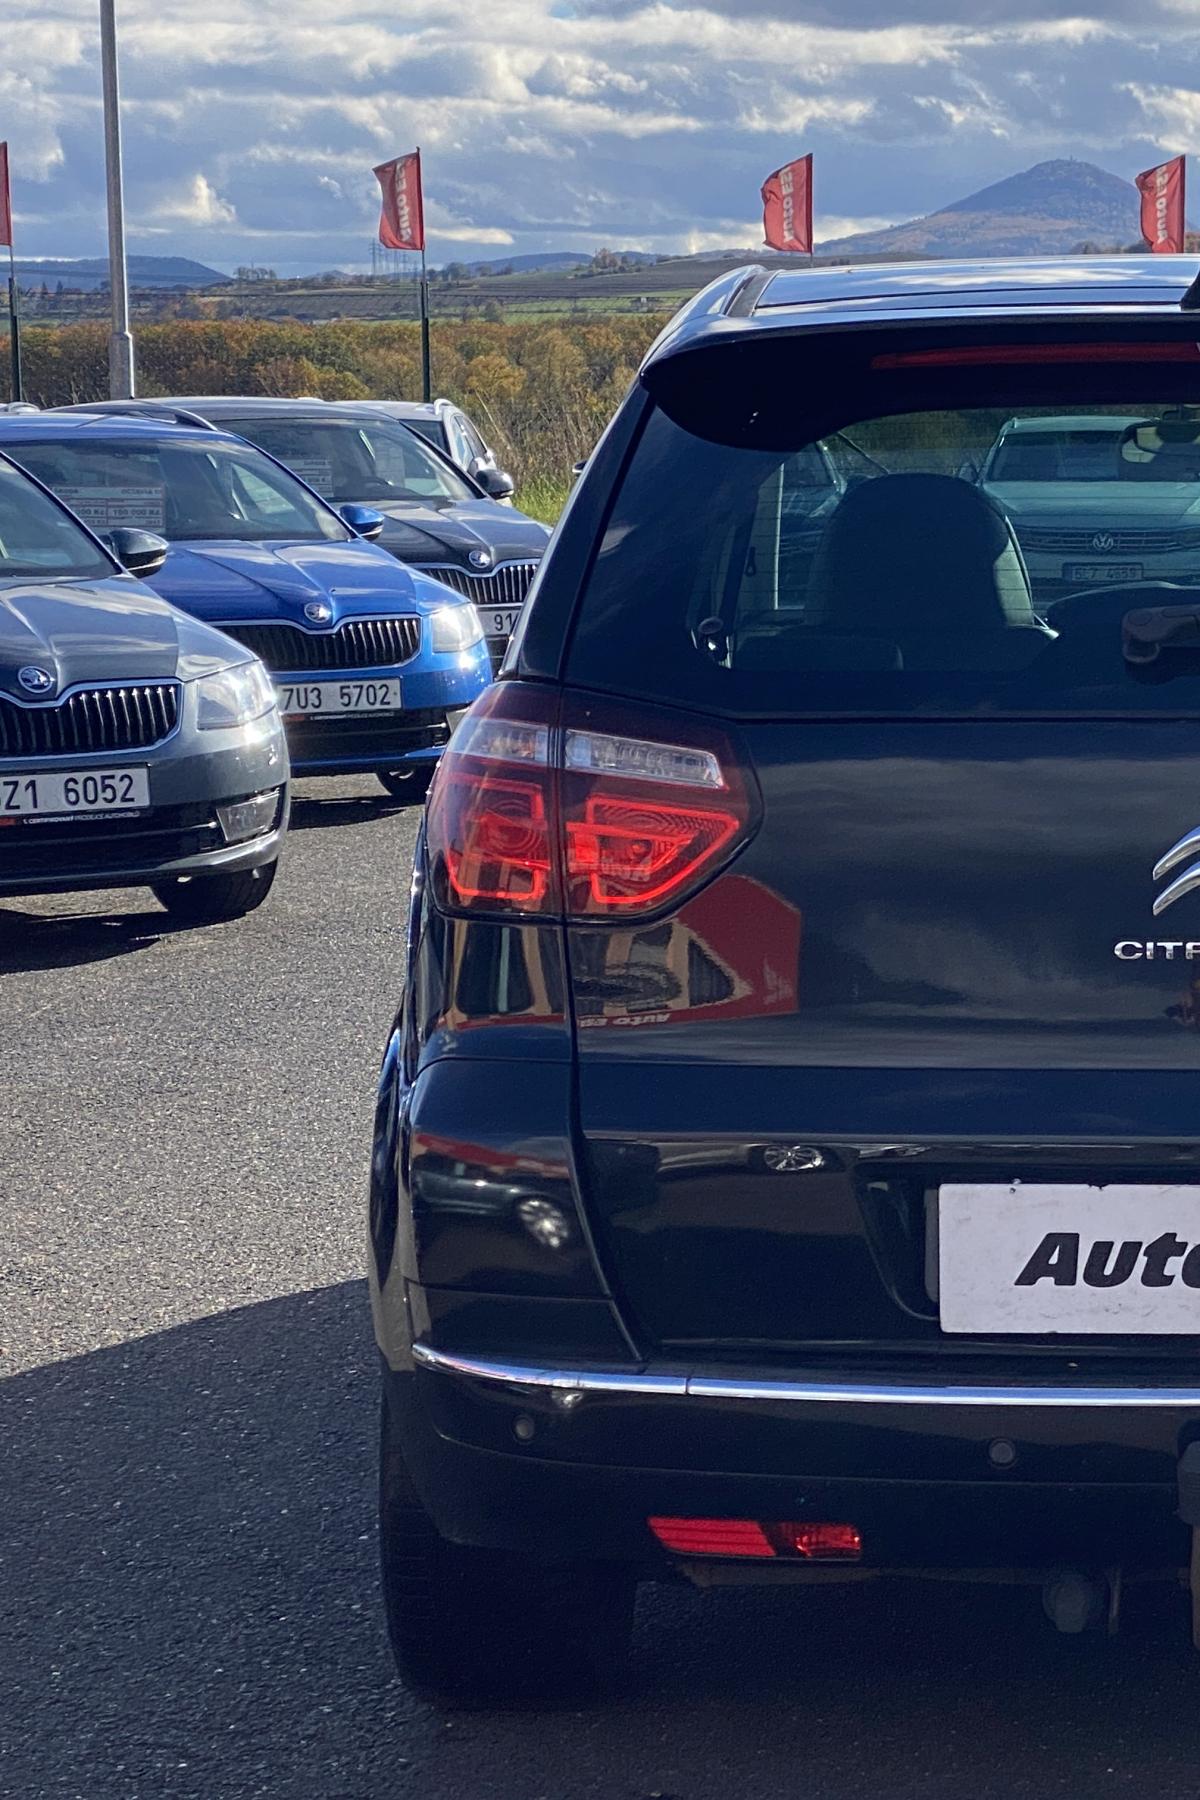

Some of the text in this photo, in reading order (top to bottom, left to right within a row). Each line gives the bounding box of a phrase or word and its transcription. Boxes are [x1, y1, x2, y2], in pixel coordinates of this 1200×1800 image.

[282, 684, 391, 710] 7U3 5702
[0, 774, 136, 810] Z1 6052
